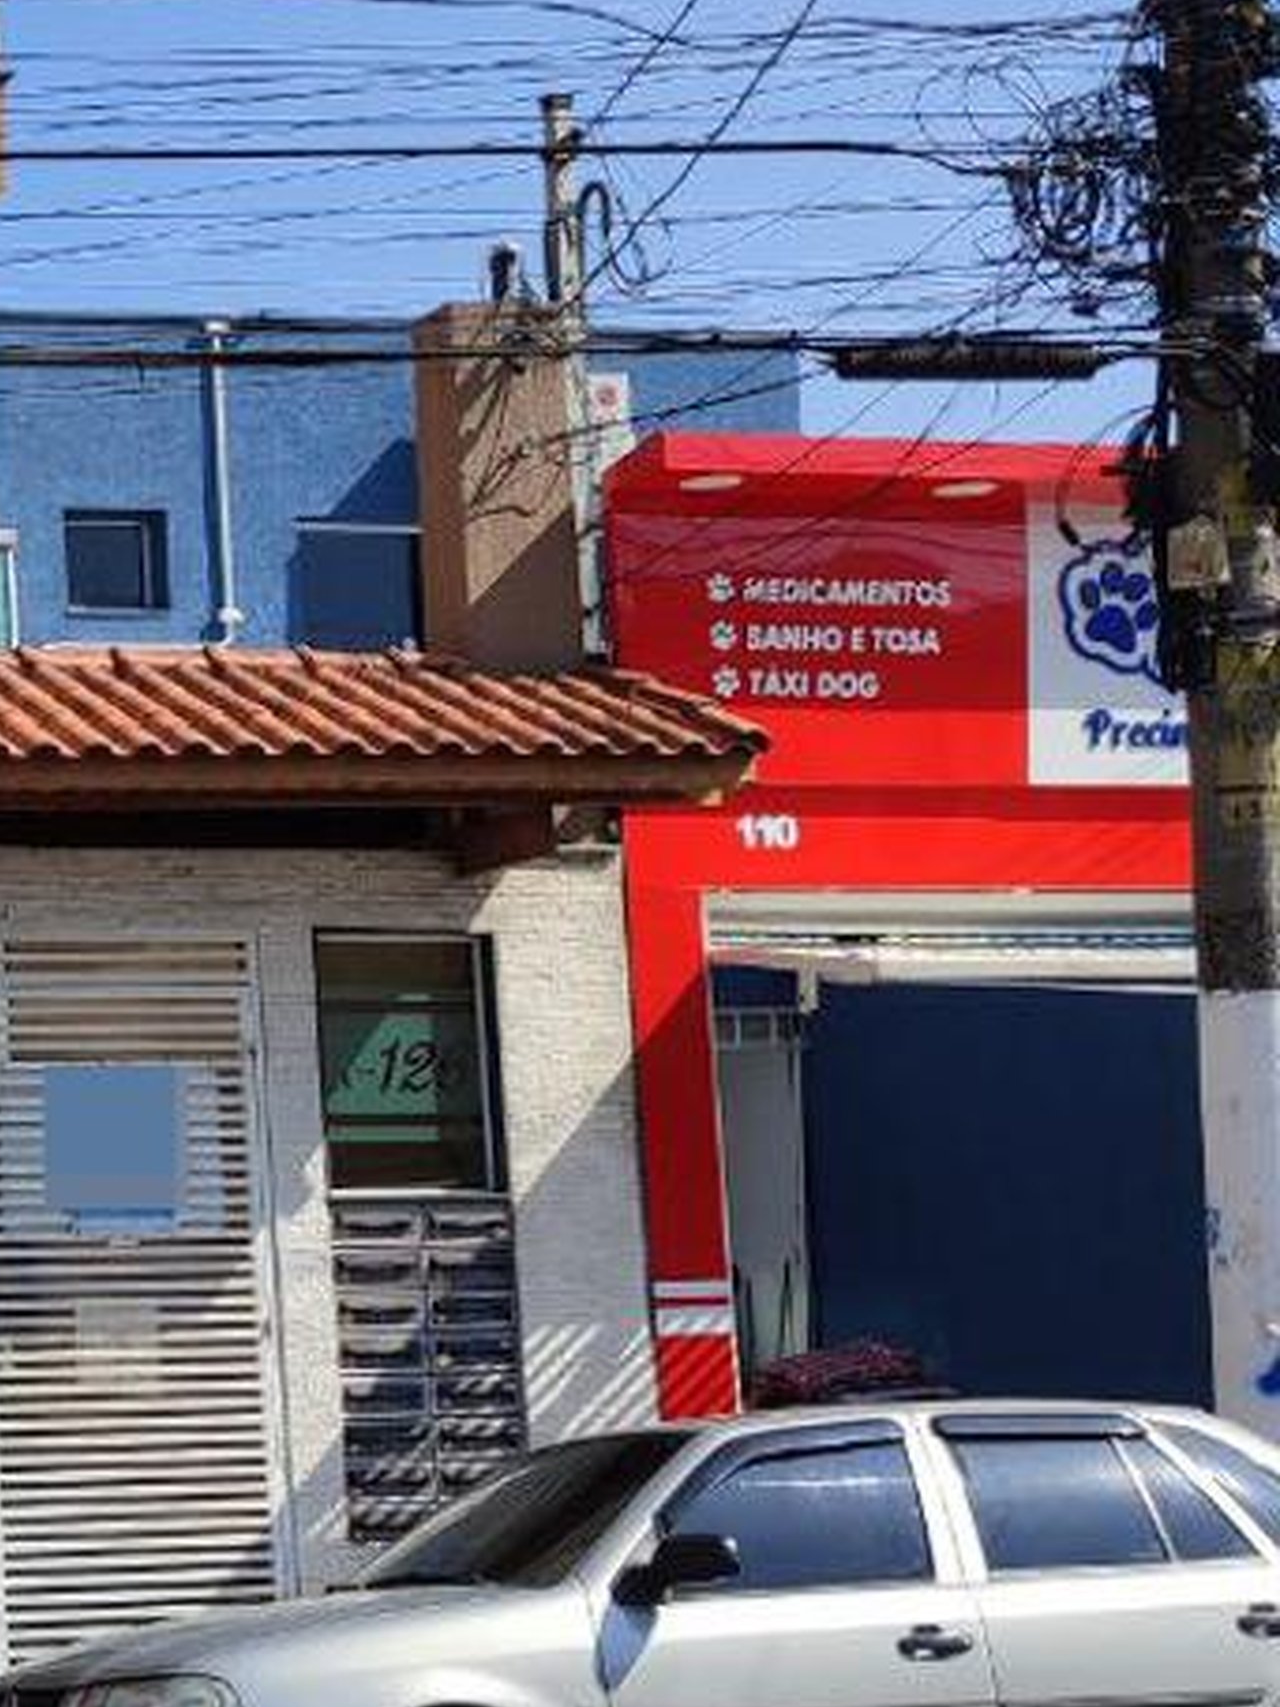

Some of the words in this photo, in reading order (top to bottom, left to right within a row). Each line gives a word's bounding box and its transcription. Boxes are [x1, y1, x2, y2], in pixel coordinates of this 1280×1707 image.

[742, 577, 951, 606] MEDICAMENTOS
[746, 625, 843, 651] BANHO
[851, 628, 867, 652] E
[872, 628, 941, 654] TOSA
[817, 671, 880, 698] DOG
[736, 814, 799, 850] 110
